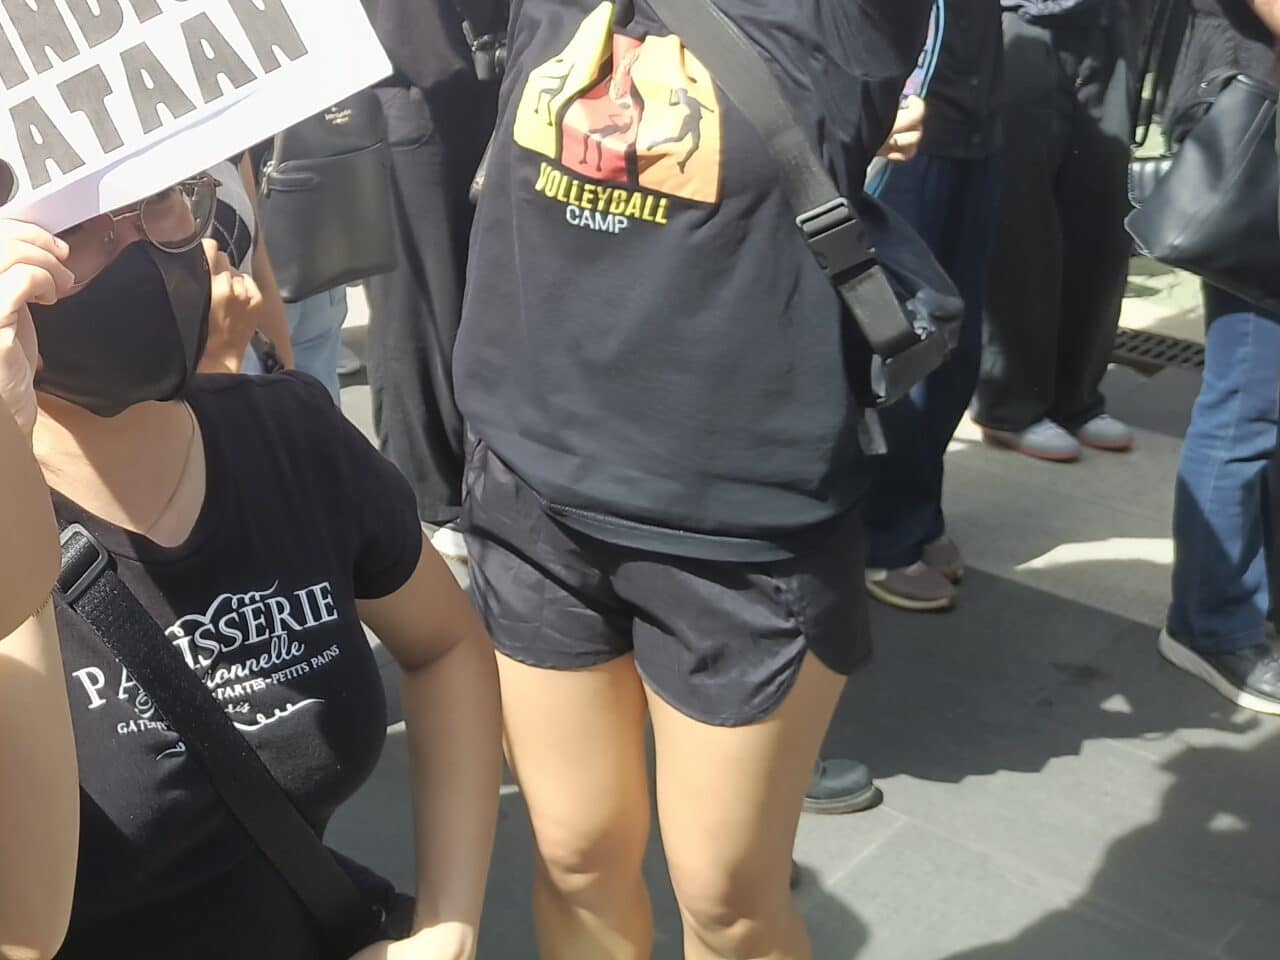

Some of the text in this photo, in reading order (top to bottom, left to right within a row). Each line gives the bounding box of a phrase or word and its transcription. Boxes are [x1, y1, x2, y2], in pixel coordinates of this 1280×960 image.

[535, 162, 669, 224] VOLLEYBALL
[566, 206, 628, 234] CAMP
[311, 643, 341, 669] PAINS
